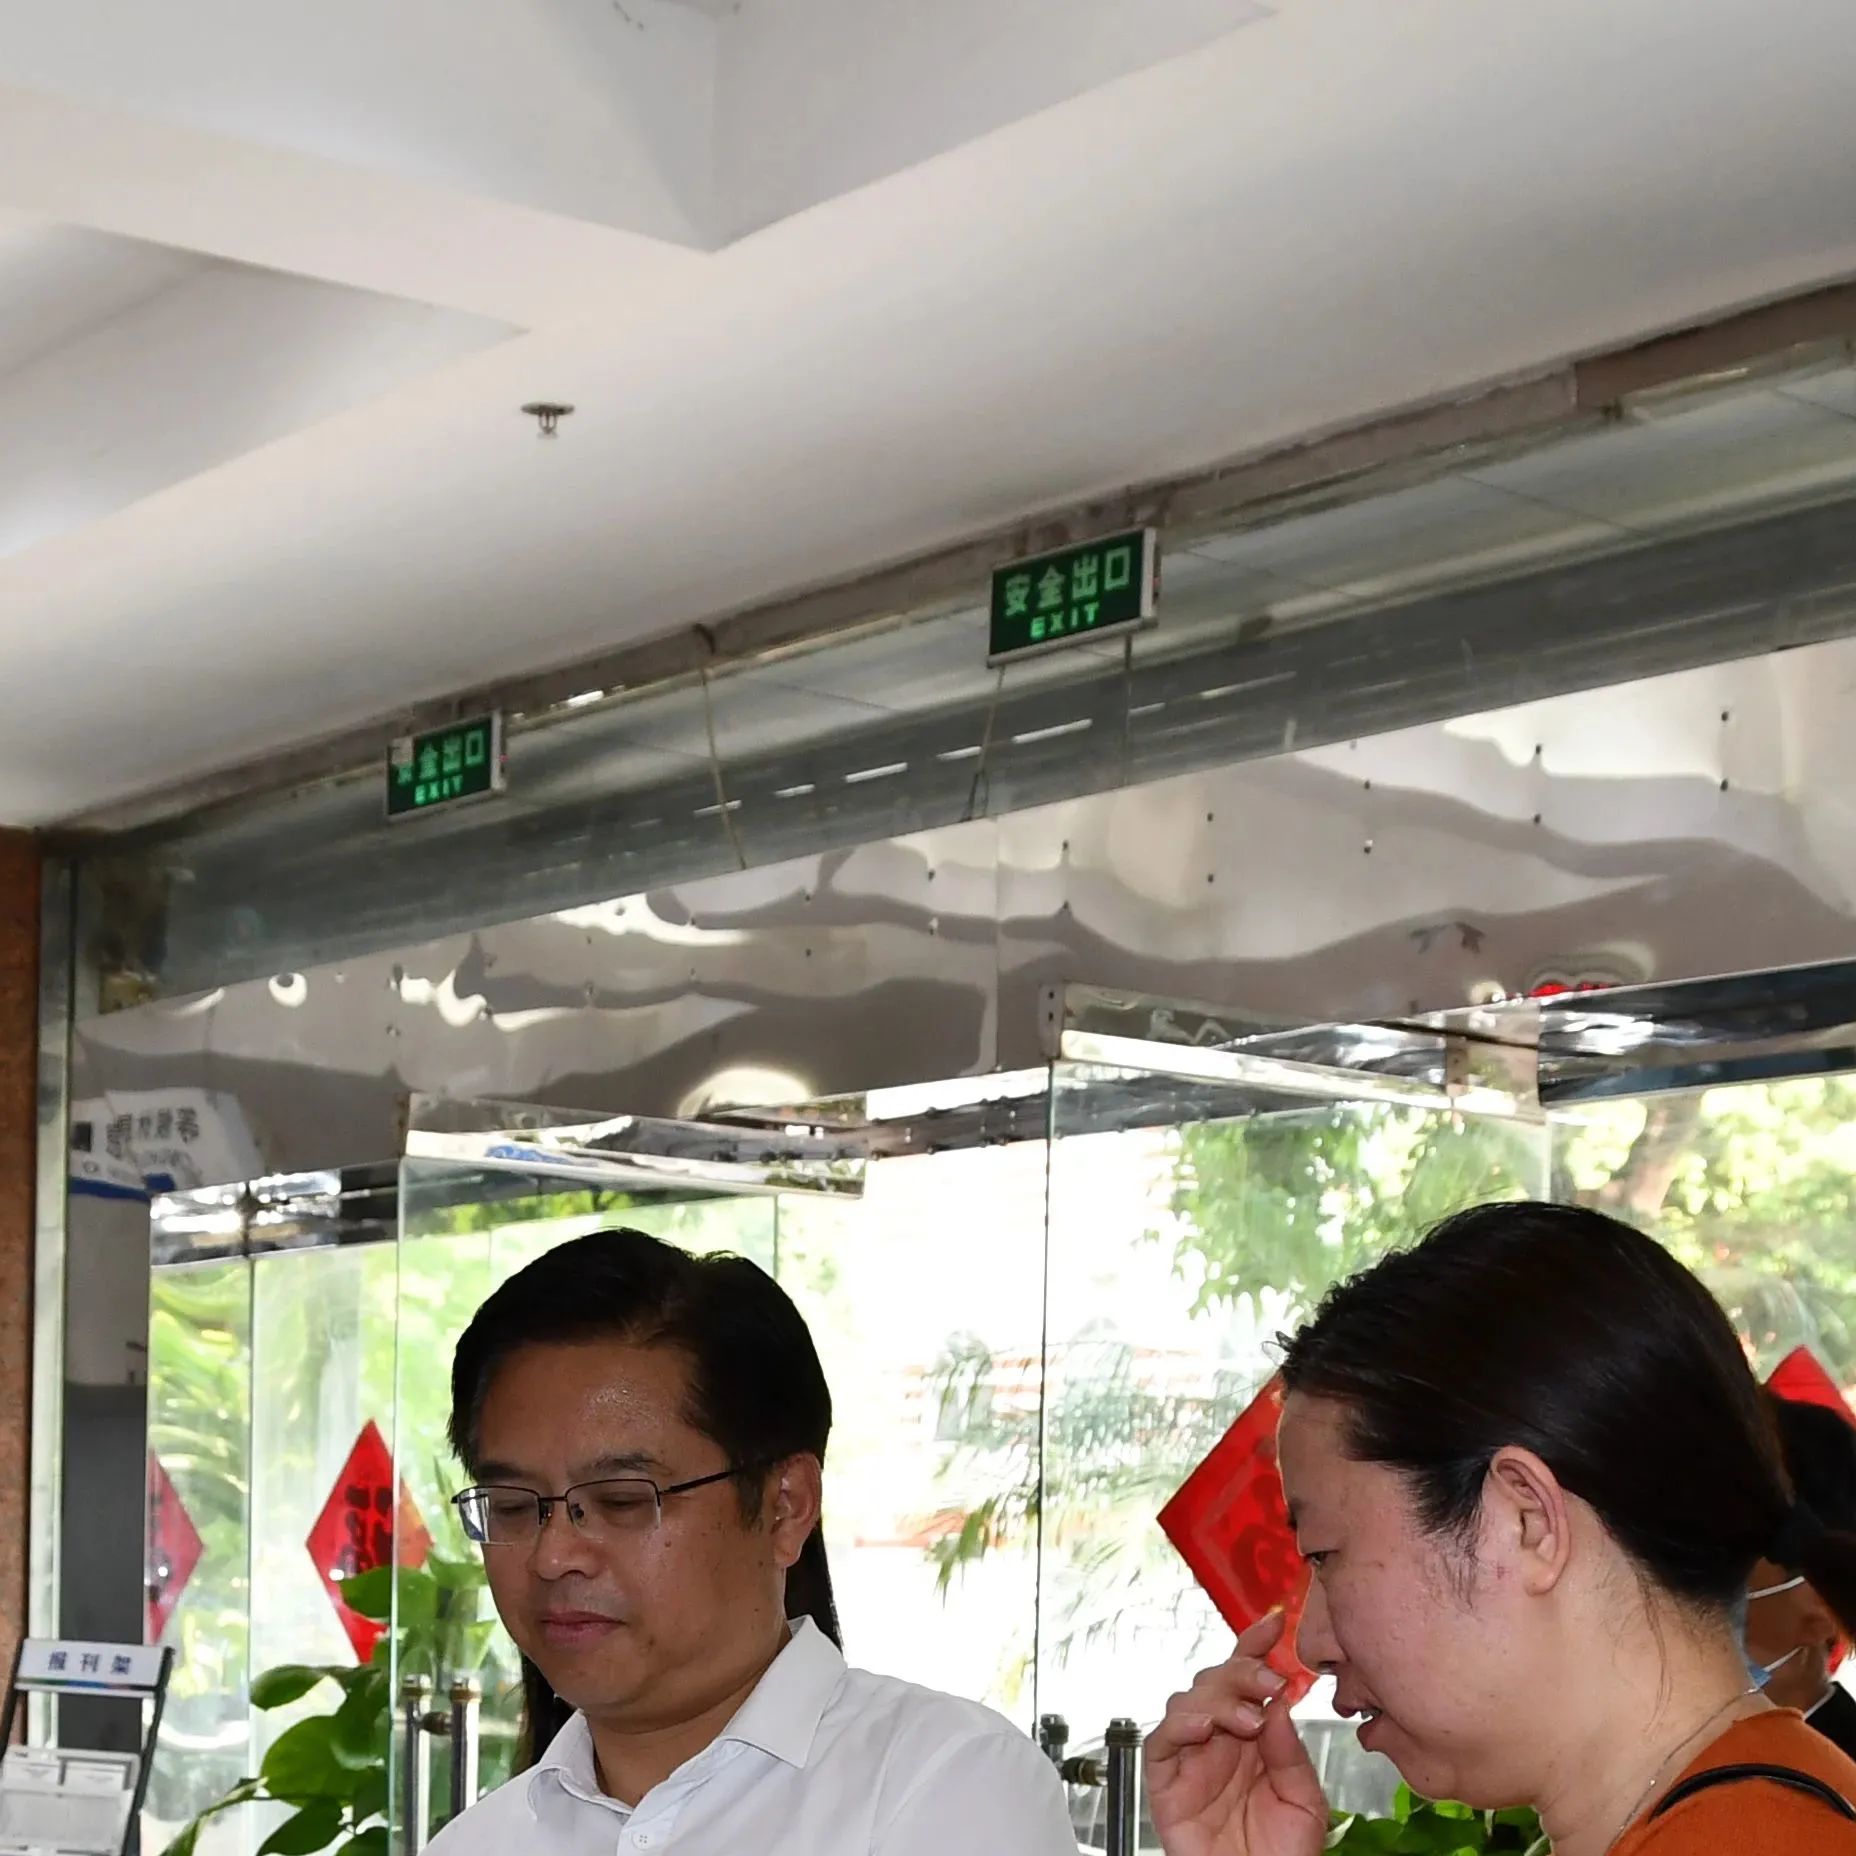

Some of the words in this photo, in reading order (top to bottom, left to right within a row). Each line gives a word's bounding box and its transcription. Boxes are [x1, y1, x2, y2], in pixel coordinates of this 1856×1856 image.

[1005, 546, 1132, 619] 安全出口
[1030, 601, 1100, 639] EXIT
